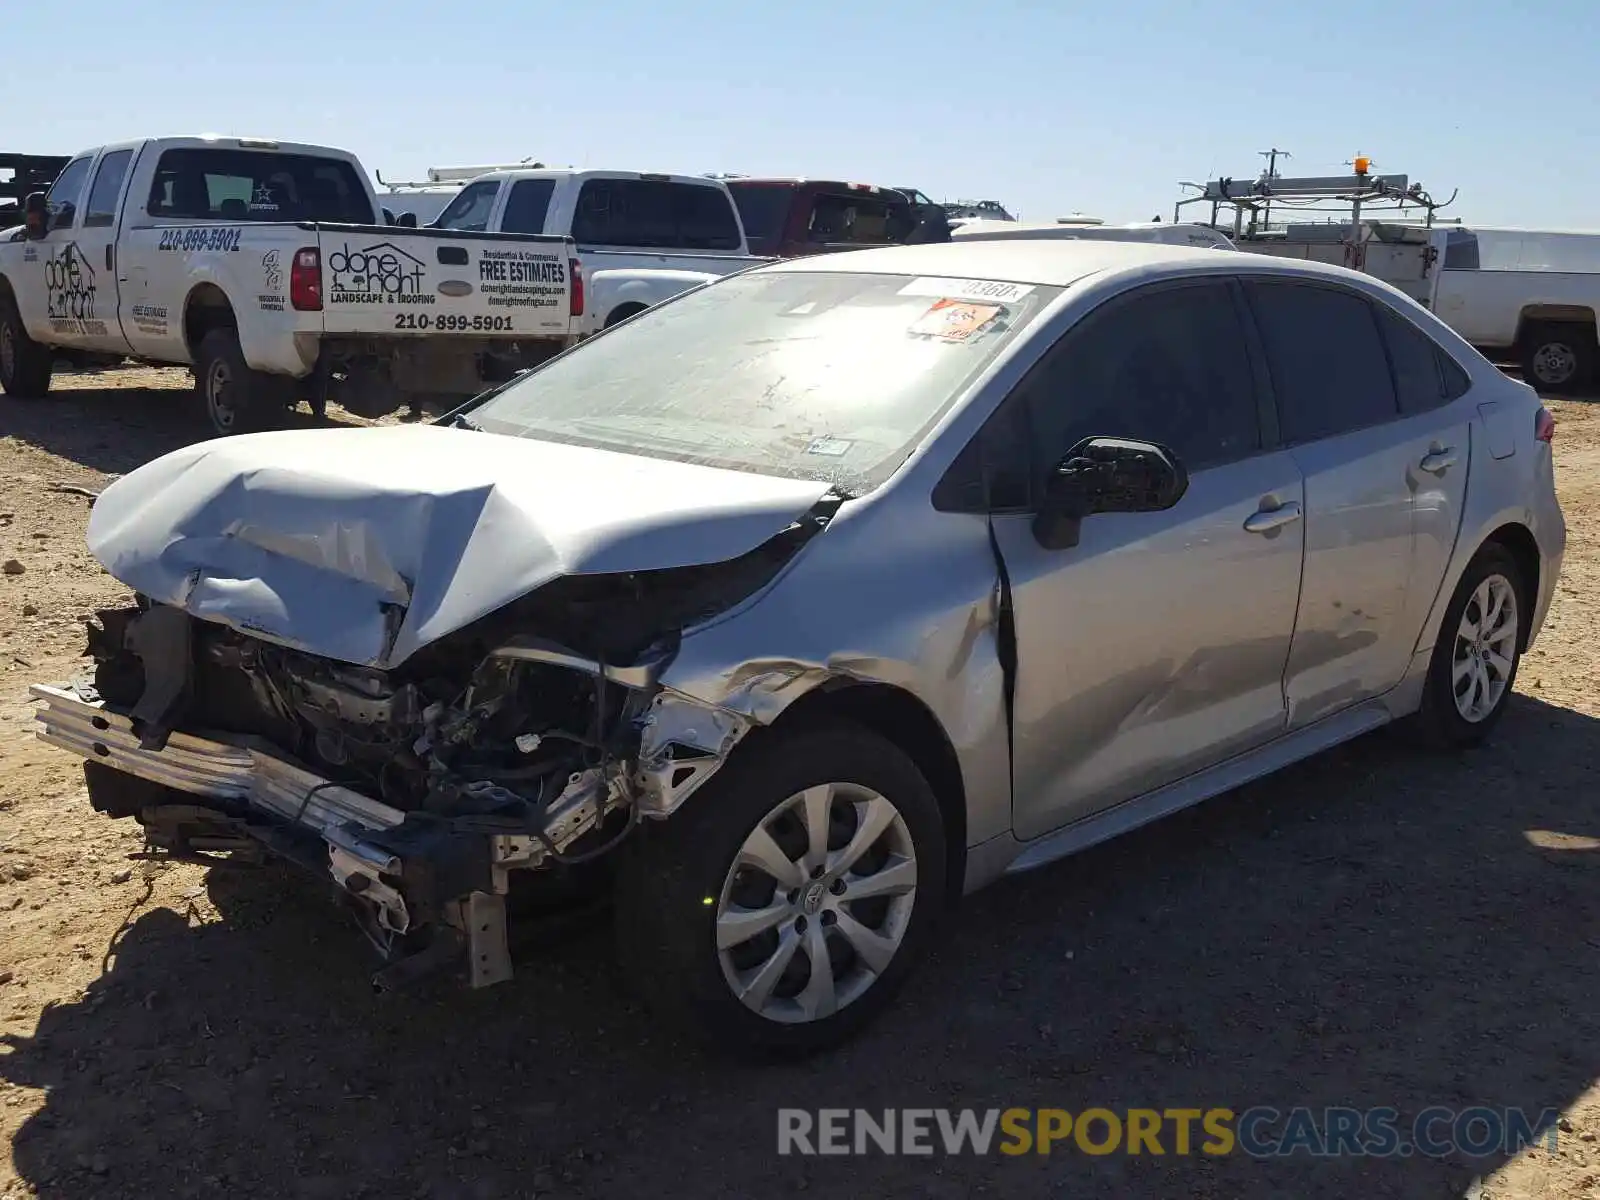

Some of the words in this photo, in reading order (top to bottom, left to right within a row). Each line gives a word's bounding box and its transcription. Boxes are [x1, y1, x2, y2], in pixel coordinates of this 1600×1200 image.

[158, 227, 242, 252] 210-899-5901
[328, 243, 399, 274] done
[483, 249, 518, 261] Residential
[525, 252, 559, 262] Commercial
[479, 260, 507, 281] FREE
[509, 261, 565, 284] ESTIMATES
[330, 293, 384, 304] LANDSCAPE
[387, 294, 394, 304] &
[398, 295, 436, 305] ROOFING
[394, 313, 514, 331] 210-899-5901
